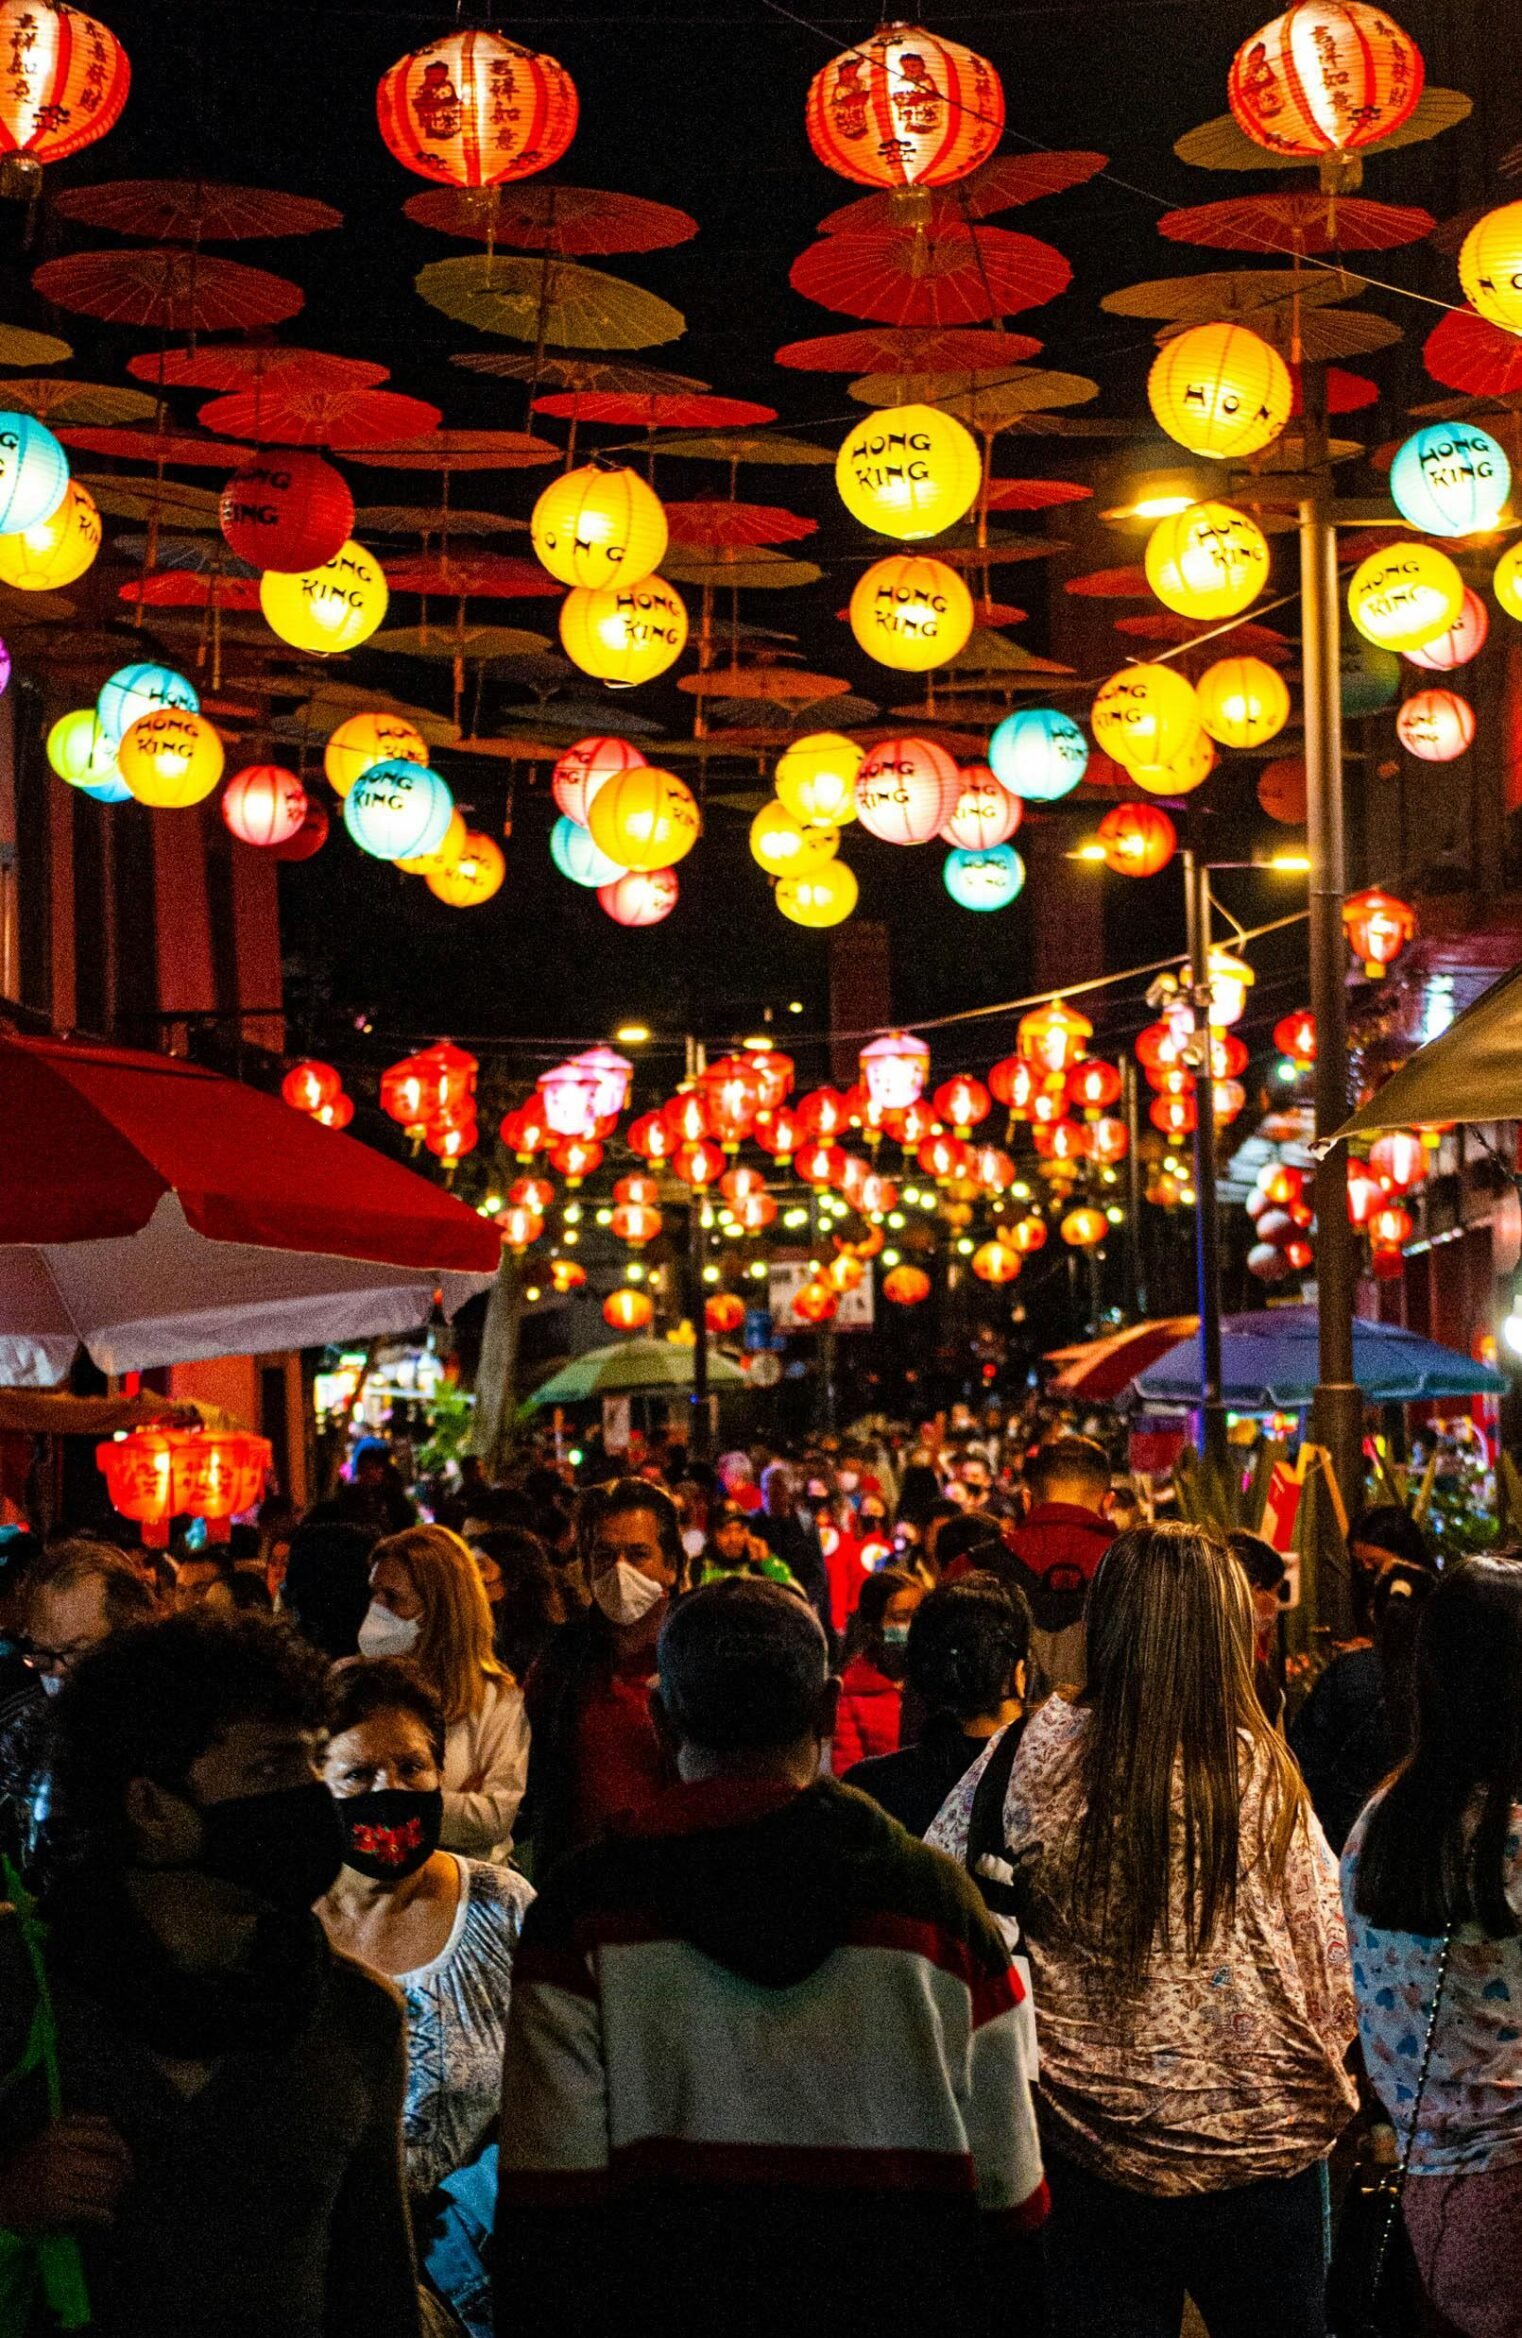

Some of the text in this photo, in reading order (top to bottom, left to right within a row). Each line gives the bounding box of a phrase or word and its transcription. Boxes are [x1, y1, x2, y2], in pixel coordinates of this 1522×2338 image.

[851, 433, 932, 465] HONG
[1419, 437, 1490, 470] HONG
[855, 461, 929, 492] KING
[1429, 462, 1494, 487] KING
[1211, 547, 1263, 569] KING
[1359, 560, 1421, 594] HONG
[301, 577, 364, 609] KING
[875, 585, 948, 613] HONG
[624, 619, 680, 645] KING
[875, 609, 938, 637] KING
[136, 718, 199, 738] HONG
[137, 737, 194, 759] KING
[354, 768, 414, 791] HONG
[858, 761, 915, 781] HONG
[351, 789, 404, 811] KING
[858, 788, 911, 811] KING
